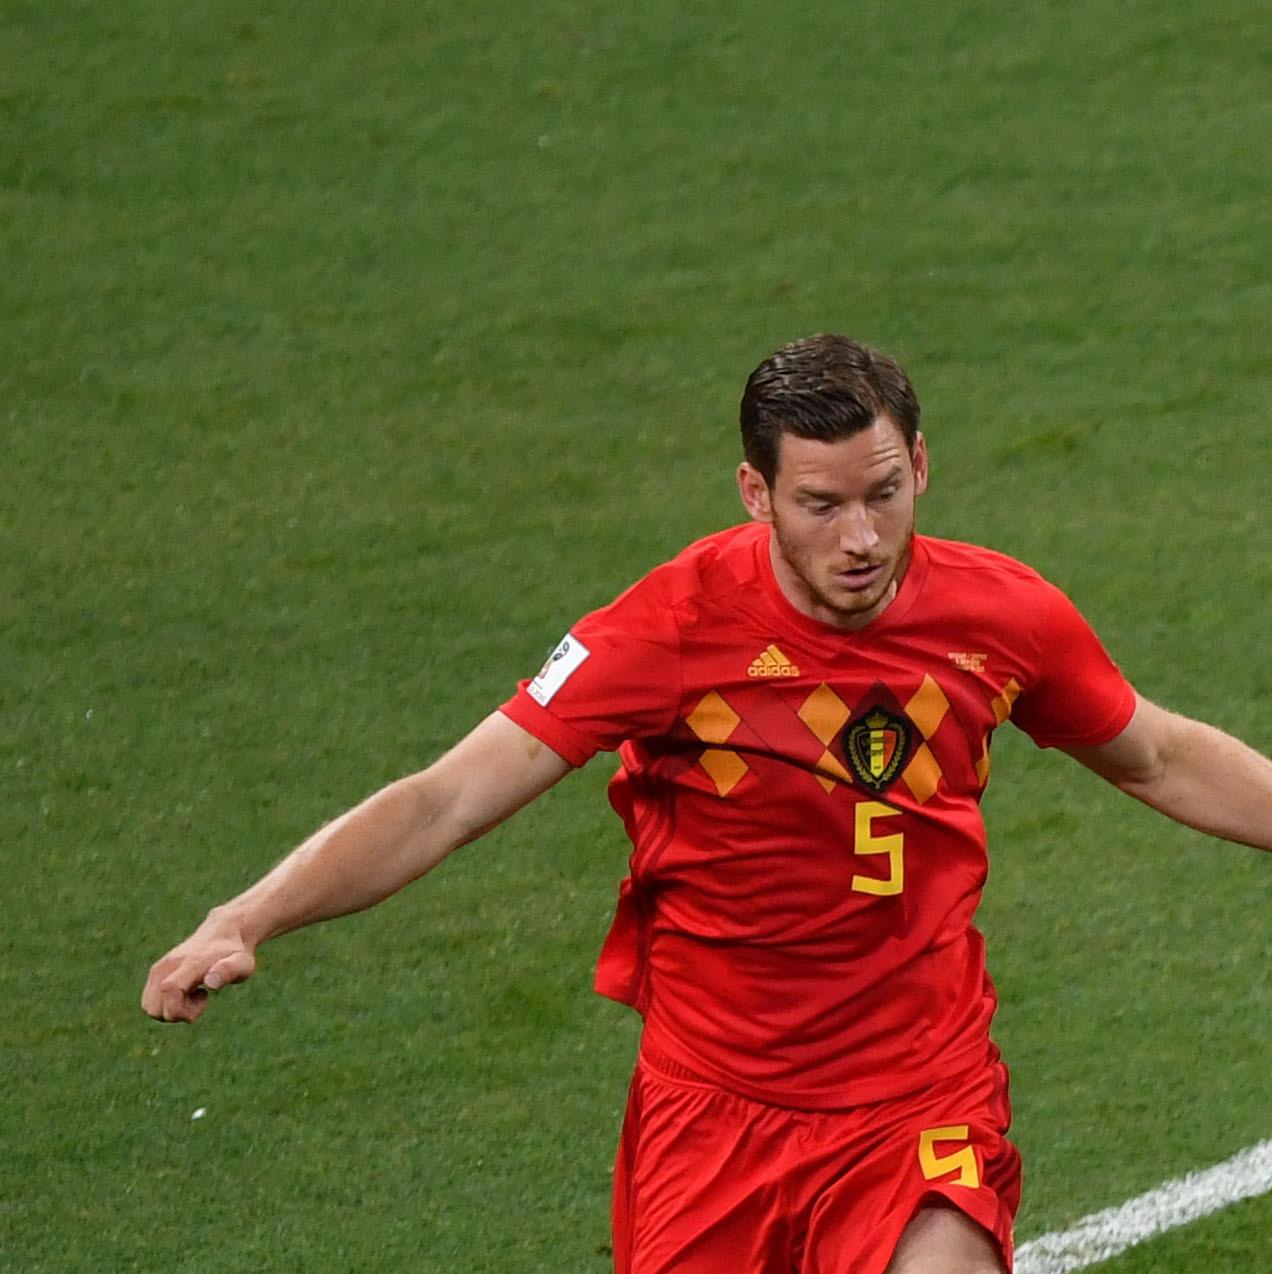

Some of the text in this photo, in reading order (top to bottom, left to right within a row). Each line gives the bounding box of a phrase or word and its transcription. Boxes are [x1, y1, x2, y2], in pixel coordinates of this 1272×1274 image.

[748, 665, 800, 677] adidas
[851, 802, 904, 895] 5
[918, 1124, 979, 1188] 5
